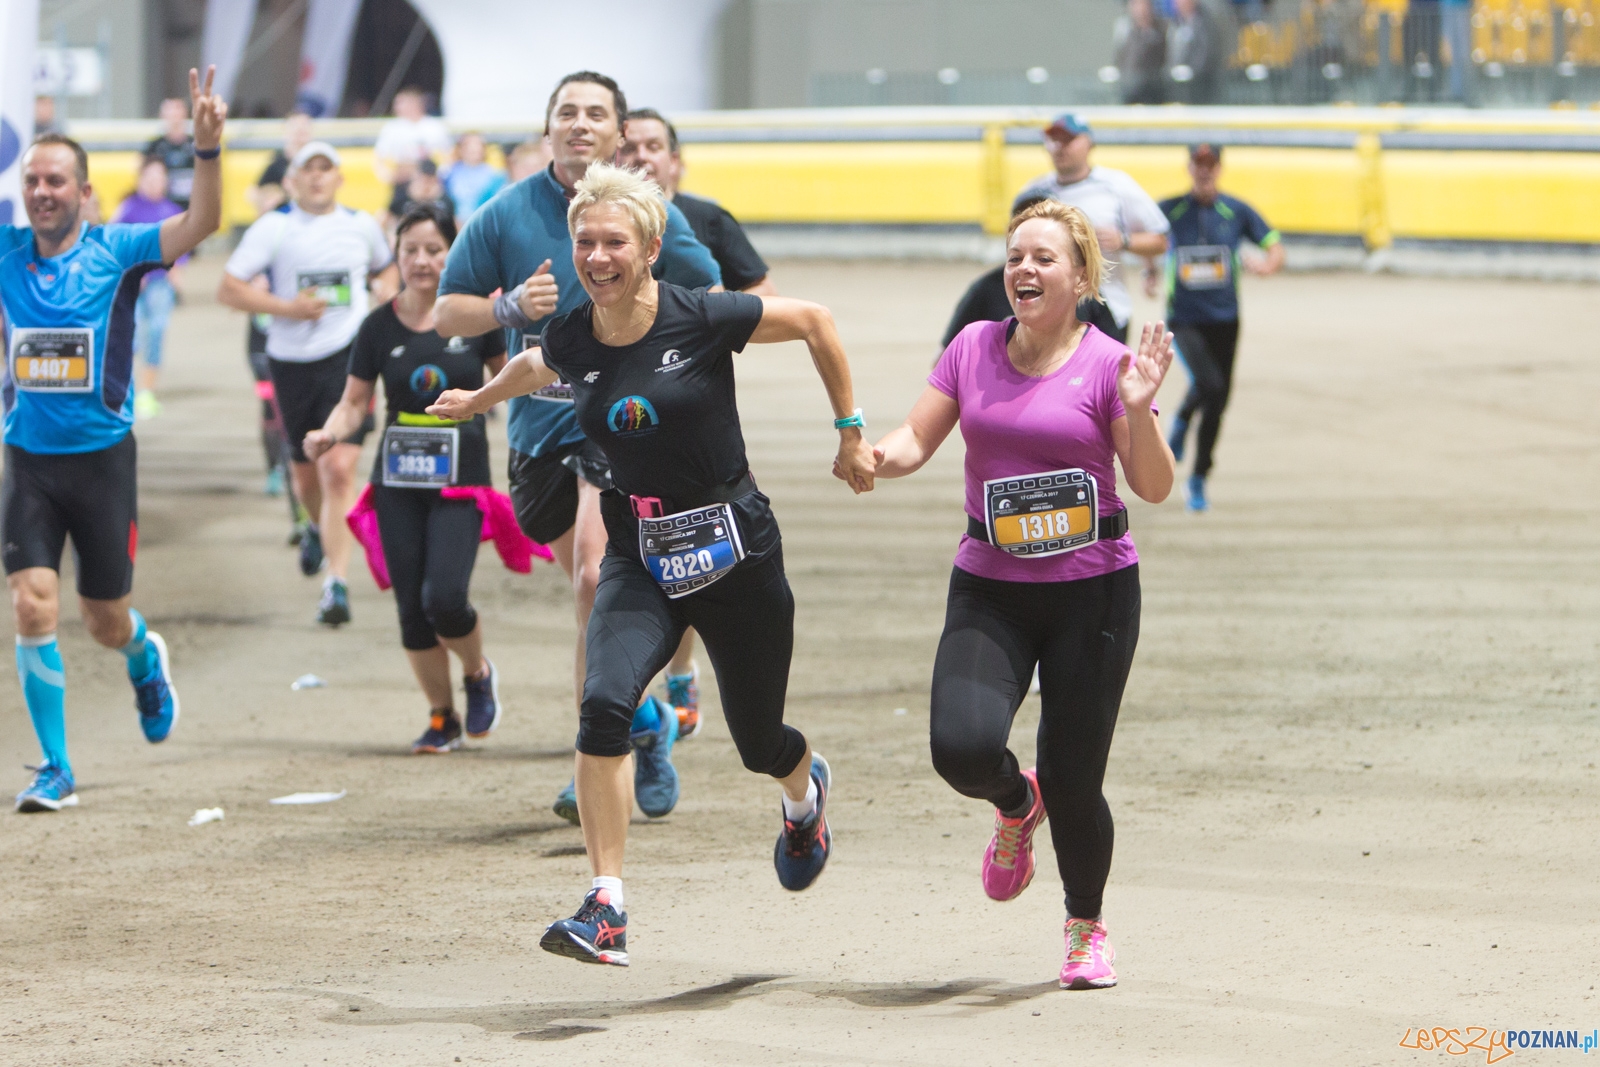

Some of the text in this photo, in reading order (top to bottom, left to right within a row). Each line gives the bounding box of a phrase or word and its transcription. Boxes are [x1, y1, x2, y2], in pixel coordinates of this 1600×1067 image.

[29, 358, 70, 378] 8407
[583, 371, 600, 383] 4F
[397, 455, 436, 475] 3833
[1026, 492, 1048, 500] CZERWCA
[1018, 511, 1070, 540] 1318
[659, 549, 714, 581] 2820
